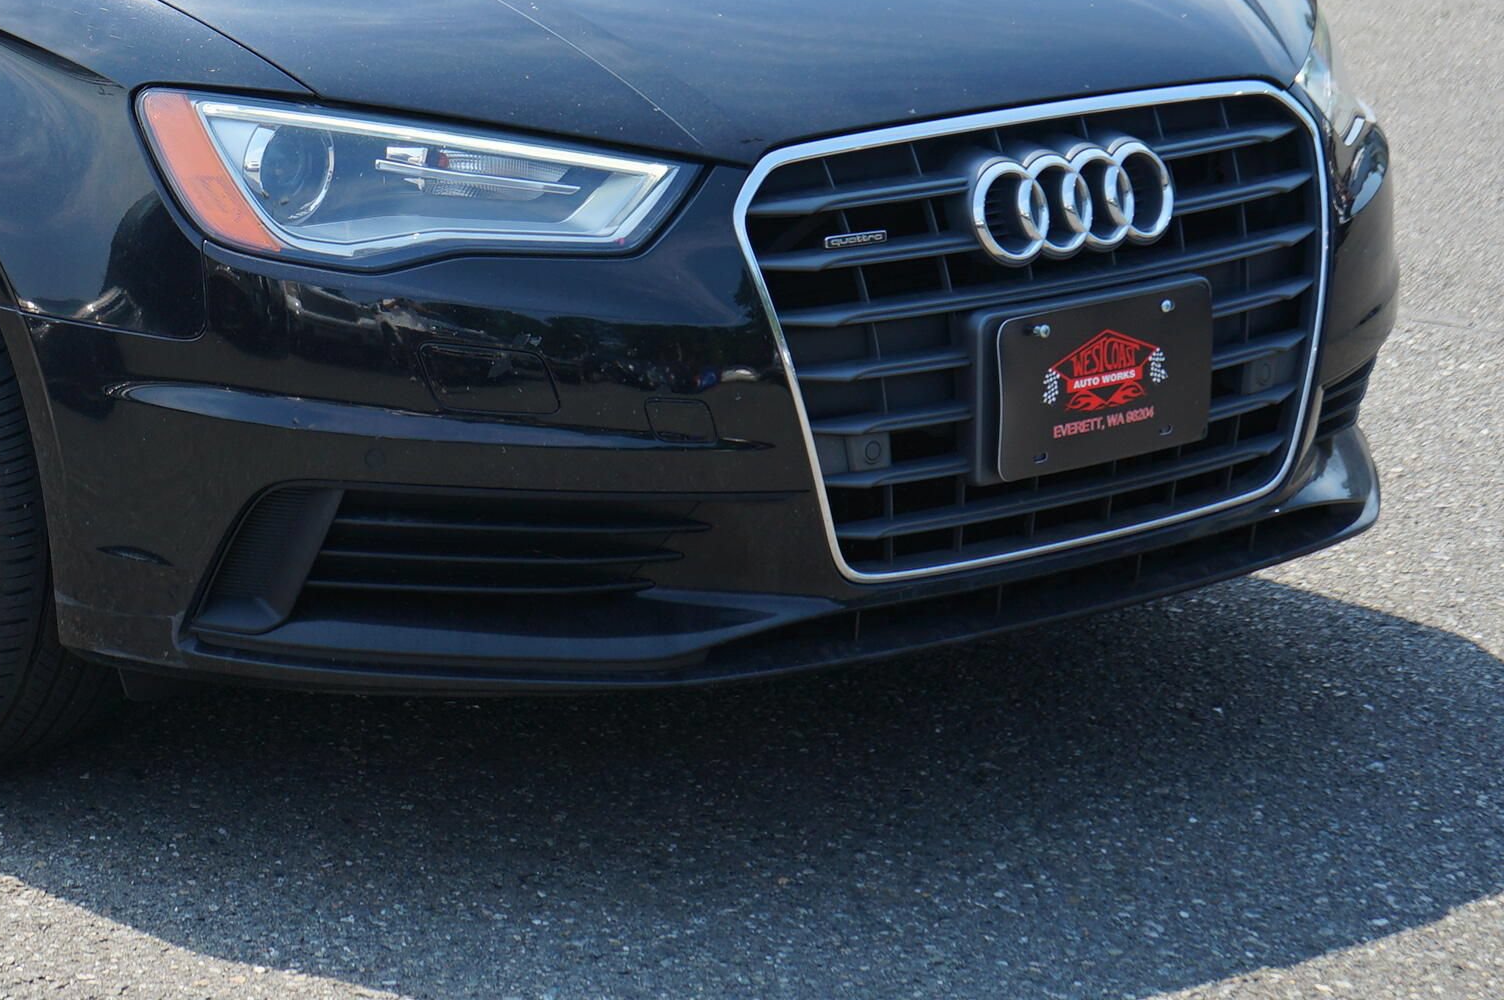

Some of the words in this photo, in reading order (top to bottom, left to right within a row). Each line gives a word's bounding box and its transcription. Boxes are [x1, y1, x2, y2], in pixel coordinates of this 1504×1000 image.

[830, 233, 883, 248] quattro
[1073, 377, 1100, 389] AUTO
[1101, 369, 1136, 384] WORKS
[1053, 416, 1105, 439] EVERETT,
[1107, 412, 1125, 427] WA
